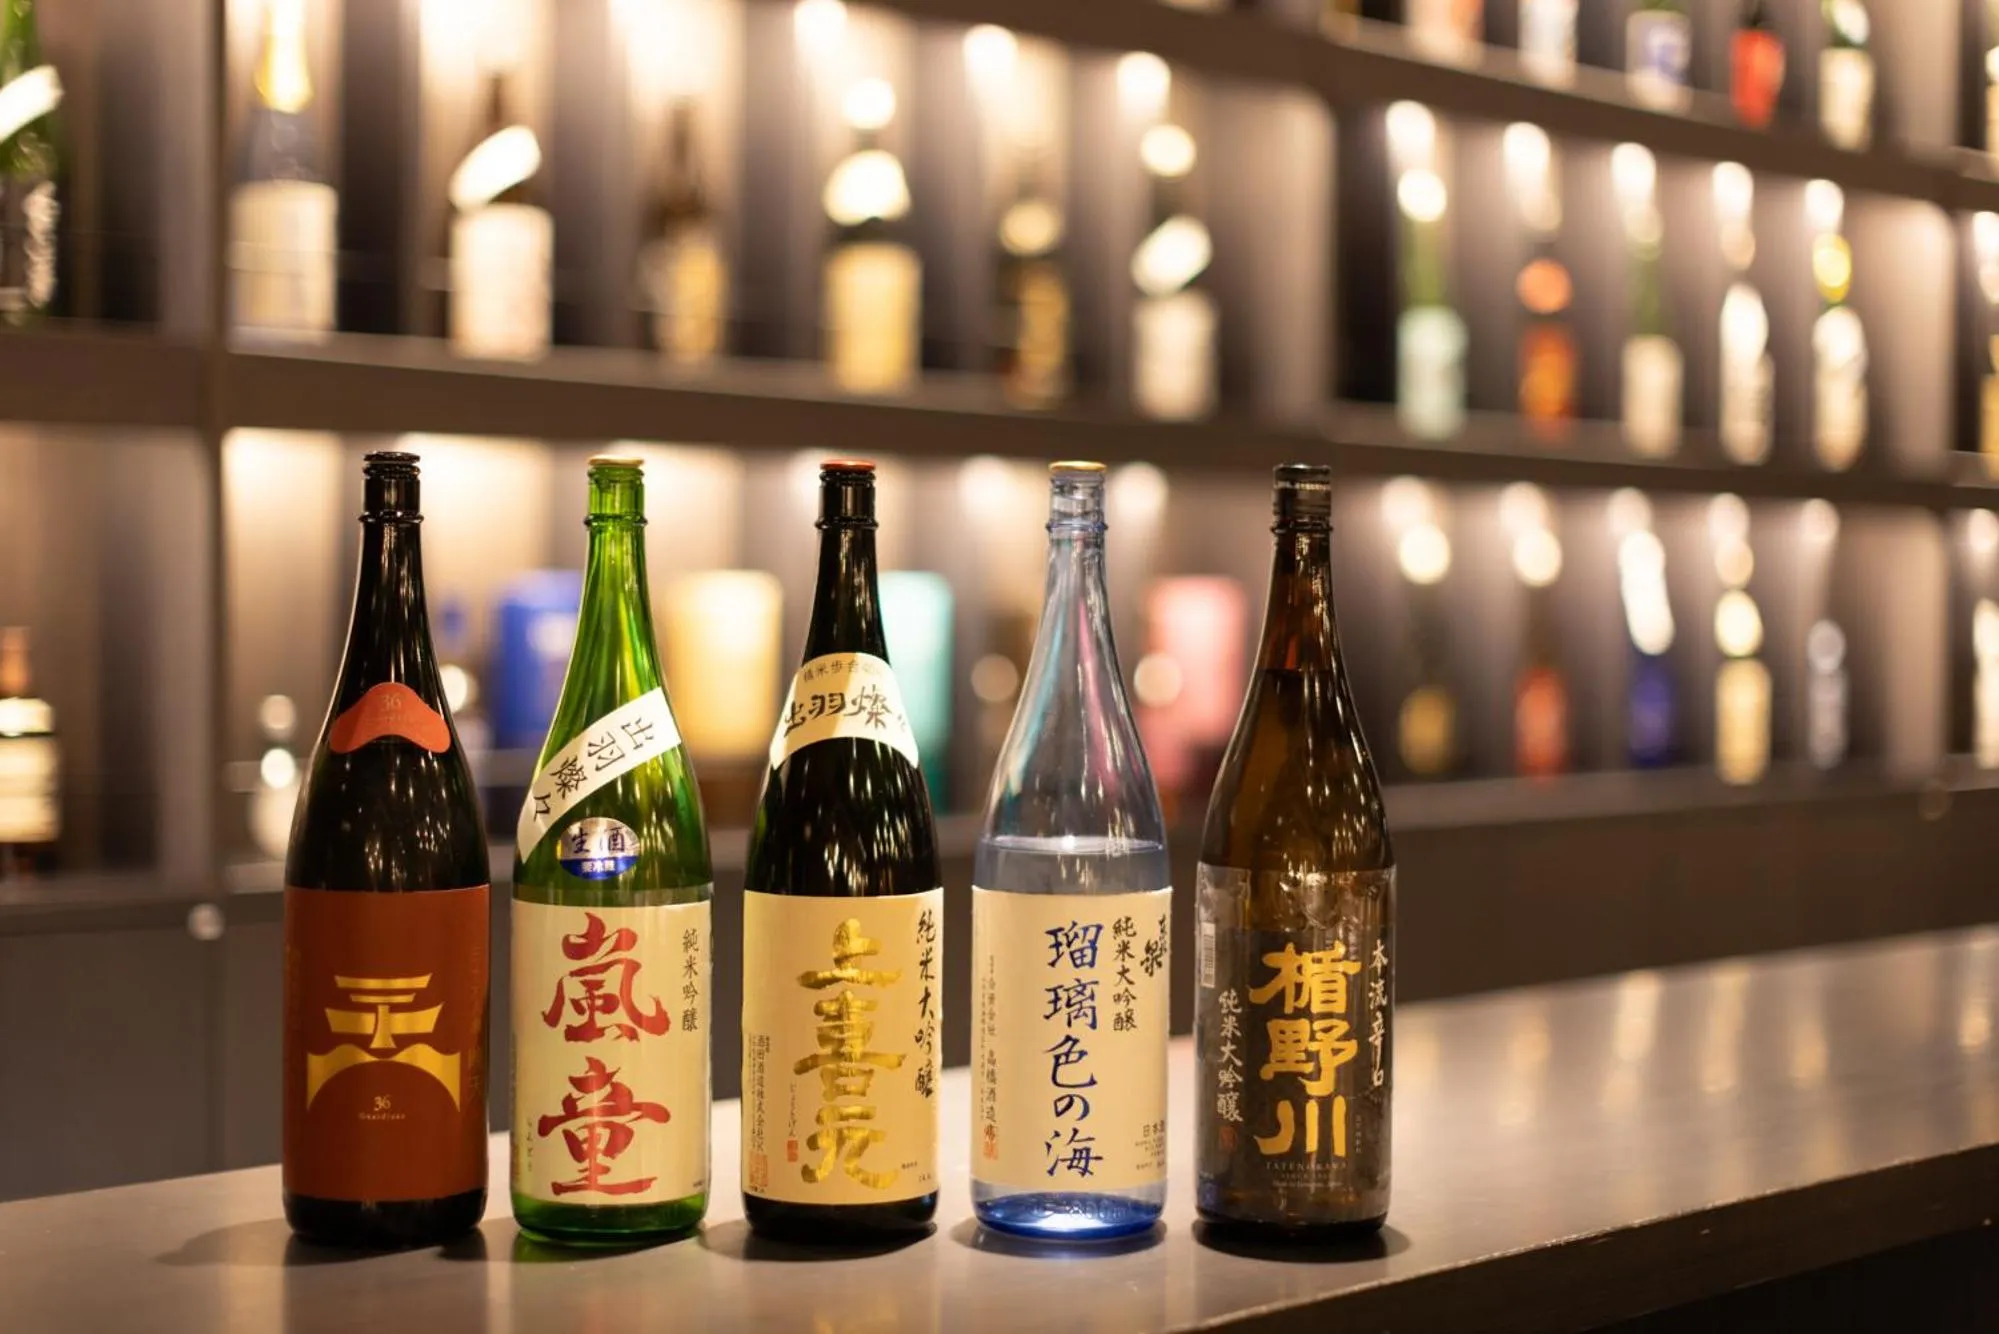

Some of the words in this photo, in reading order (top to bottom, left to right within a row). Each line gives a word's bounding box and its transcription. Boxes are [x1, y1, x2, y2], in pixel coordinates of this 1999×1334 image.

[382, 694, 402, 711] 36
[538, 912, 671, 1196] 嵐童
[682, 928, 699, 1032] 純米吟醸
[793, 917, 907, 1190] 上喜元
[915, 910, 937, 1099] 純米大吟醸
[1043, 920, 1104, 1177] 瑠璃色の海
[1112, 915, 1137, 1032] 純米大吟醸
[1249, 940, 1361, 1158] 楯野川
[374, 1096, 391, 1111] 36
[1217, 988, 1244, 1122] 純米大吟醸
